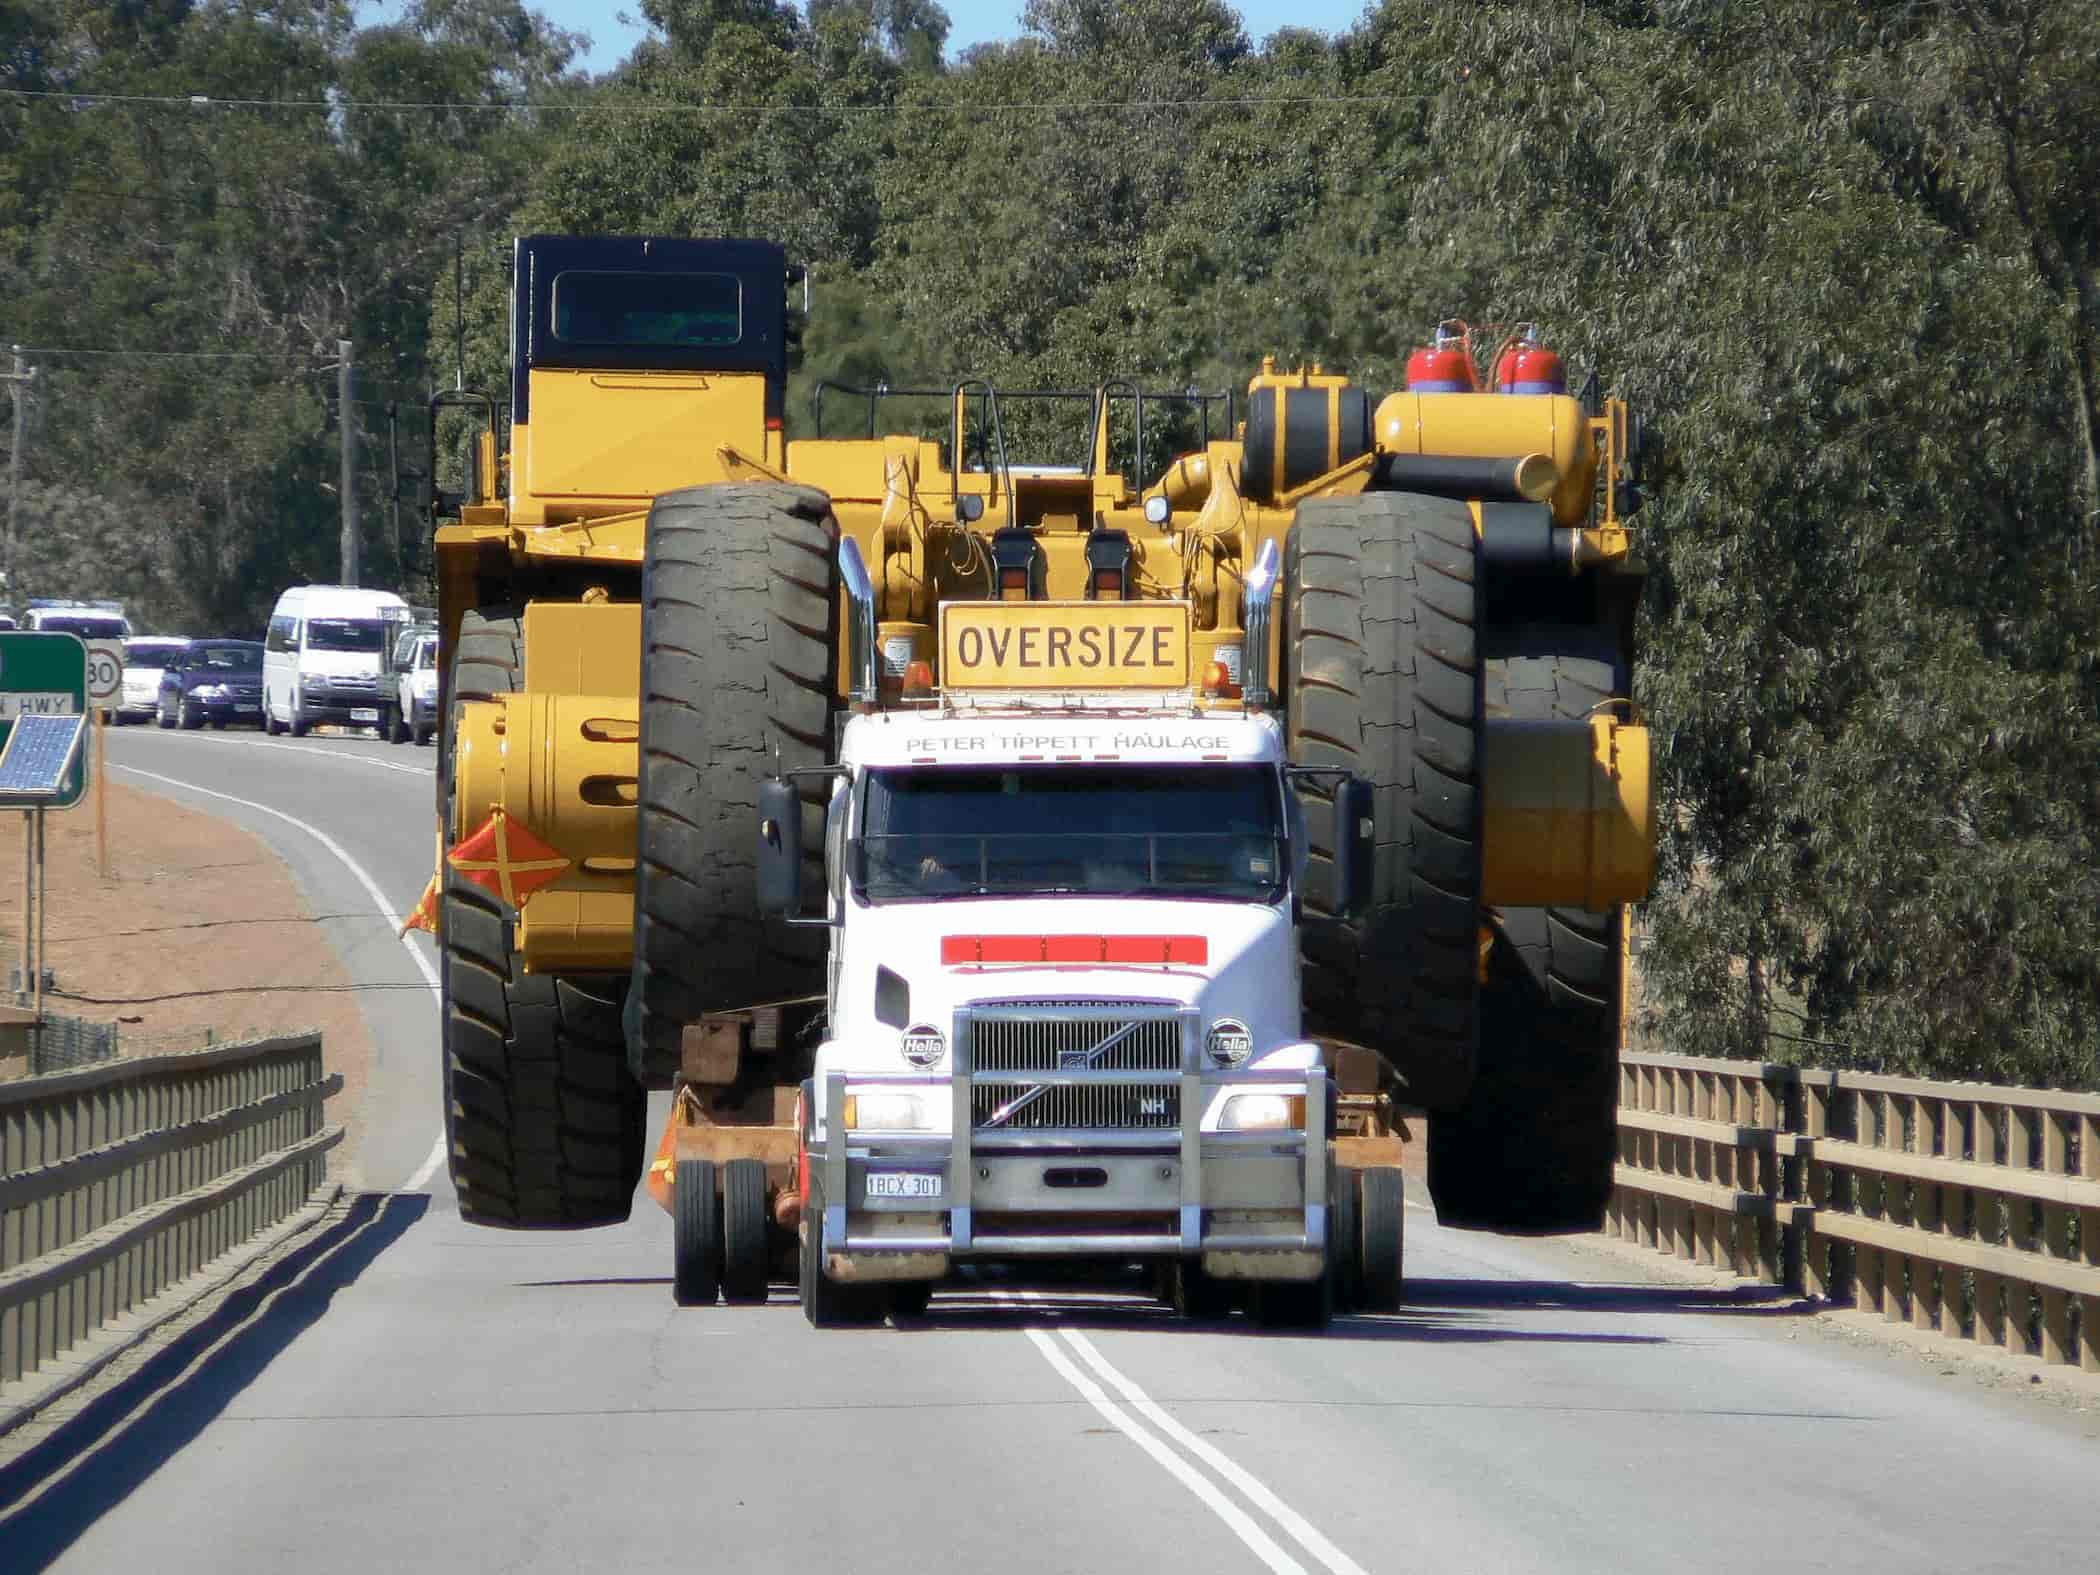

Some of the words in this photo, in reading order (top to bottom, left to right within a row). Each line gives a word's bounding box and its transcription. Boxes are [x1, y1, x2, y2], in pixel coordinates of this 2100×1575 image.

[958, 626, 1175, 668] OVERSIZE
[20, 697, 65, 713] HWY
[905, 735, 986, 752] PETER
[999, 735, 1098, 750] TIPPETT
[1113, 735, 1231, 750] HAULAGE
[903, 1037, 944, 1053] Hella
[1140, 1099, 1165, 1114] NH
